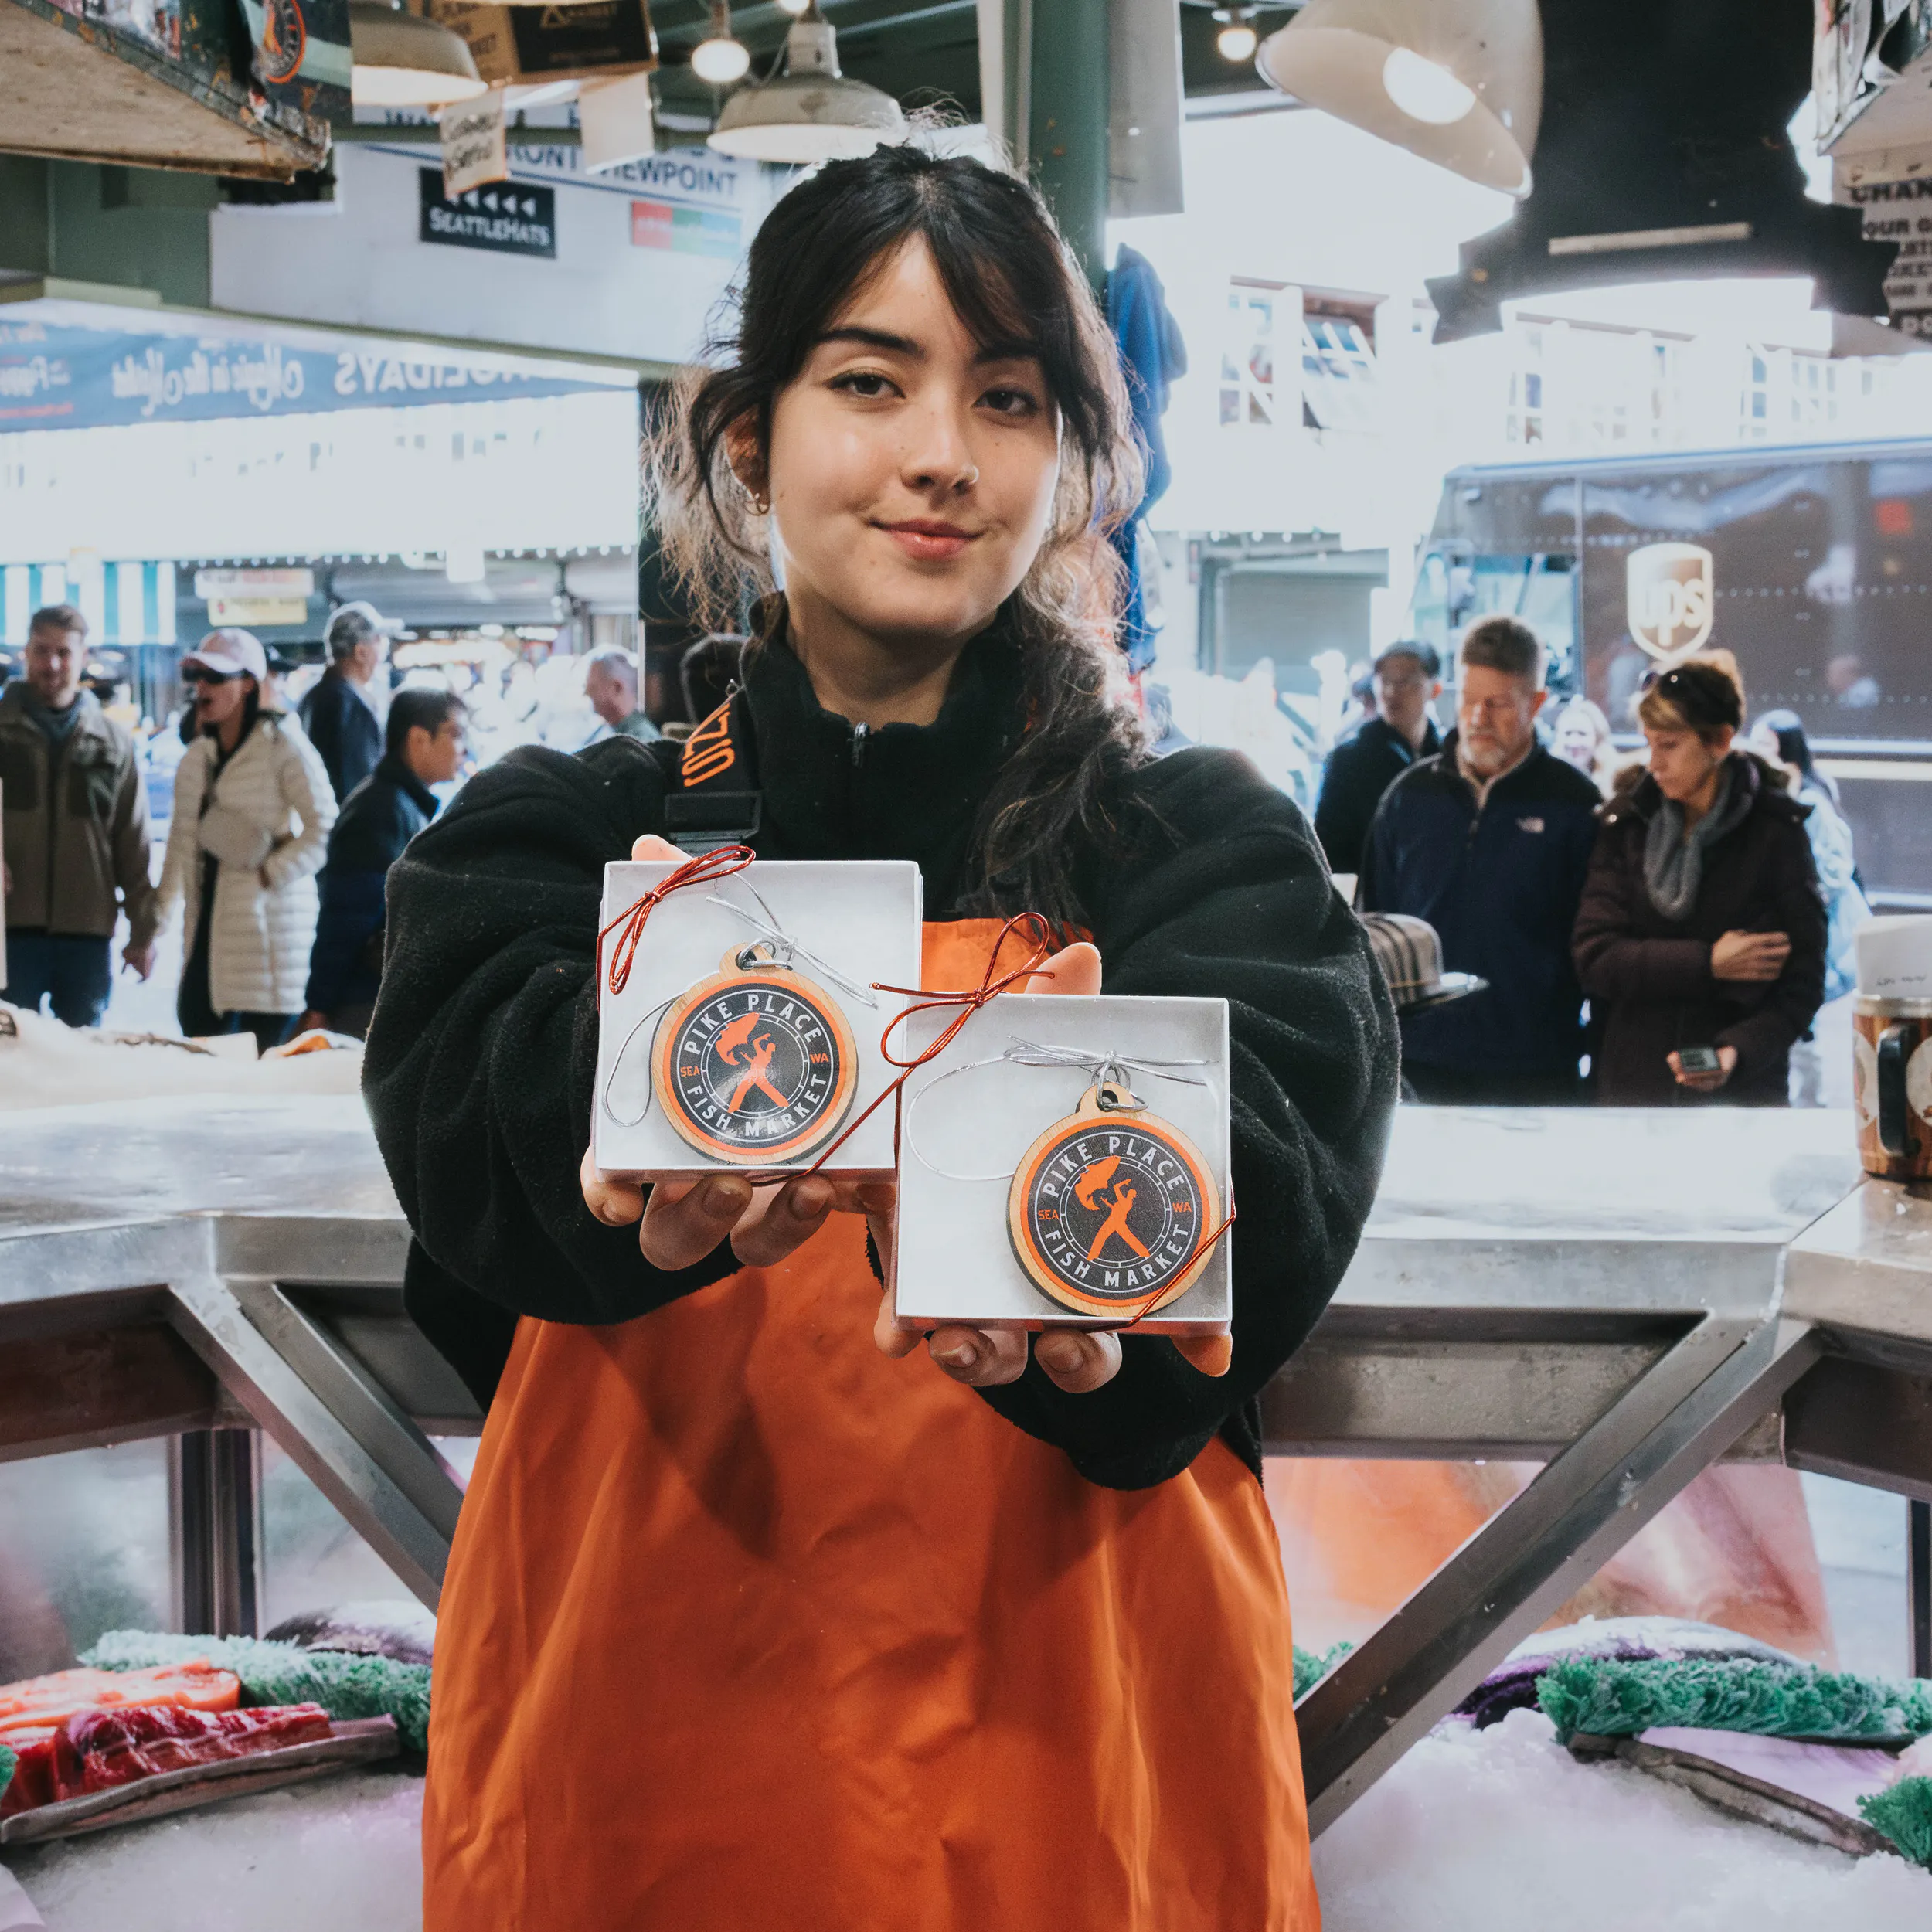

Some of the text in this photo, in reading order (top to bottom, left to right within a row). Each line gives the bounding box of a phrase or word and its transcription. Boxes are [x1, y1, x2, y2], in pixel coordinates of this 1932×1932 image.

[683, 994, 822, 1056] PIKE PLACE
[680, 1066, 701, 1078] SEA
[809, 1053, 829, 1064] WA
[687, 1073, 827, 1138] FISH MARKET
[1042, 1136, 1185, 1199] PIKE PLACE
[1037, 1209, 1060, 1220] SEA
[1172, 1202, 1192, 1213] WA
[1044, 1223, 1189, 1287] FISH MARKET
